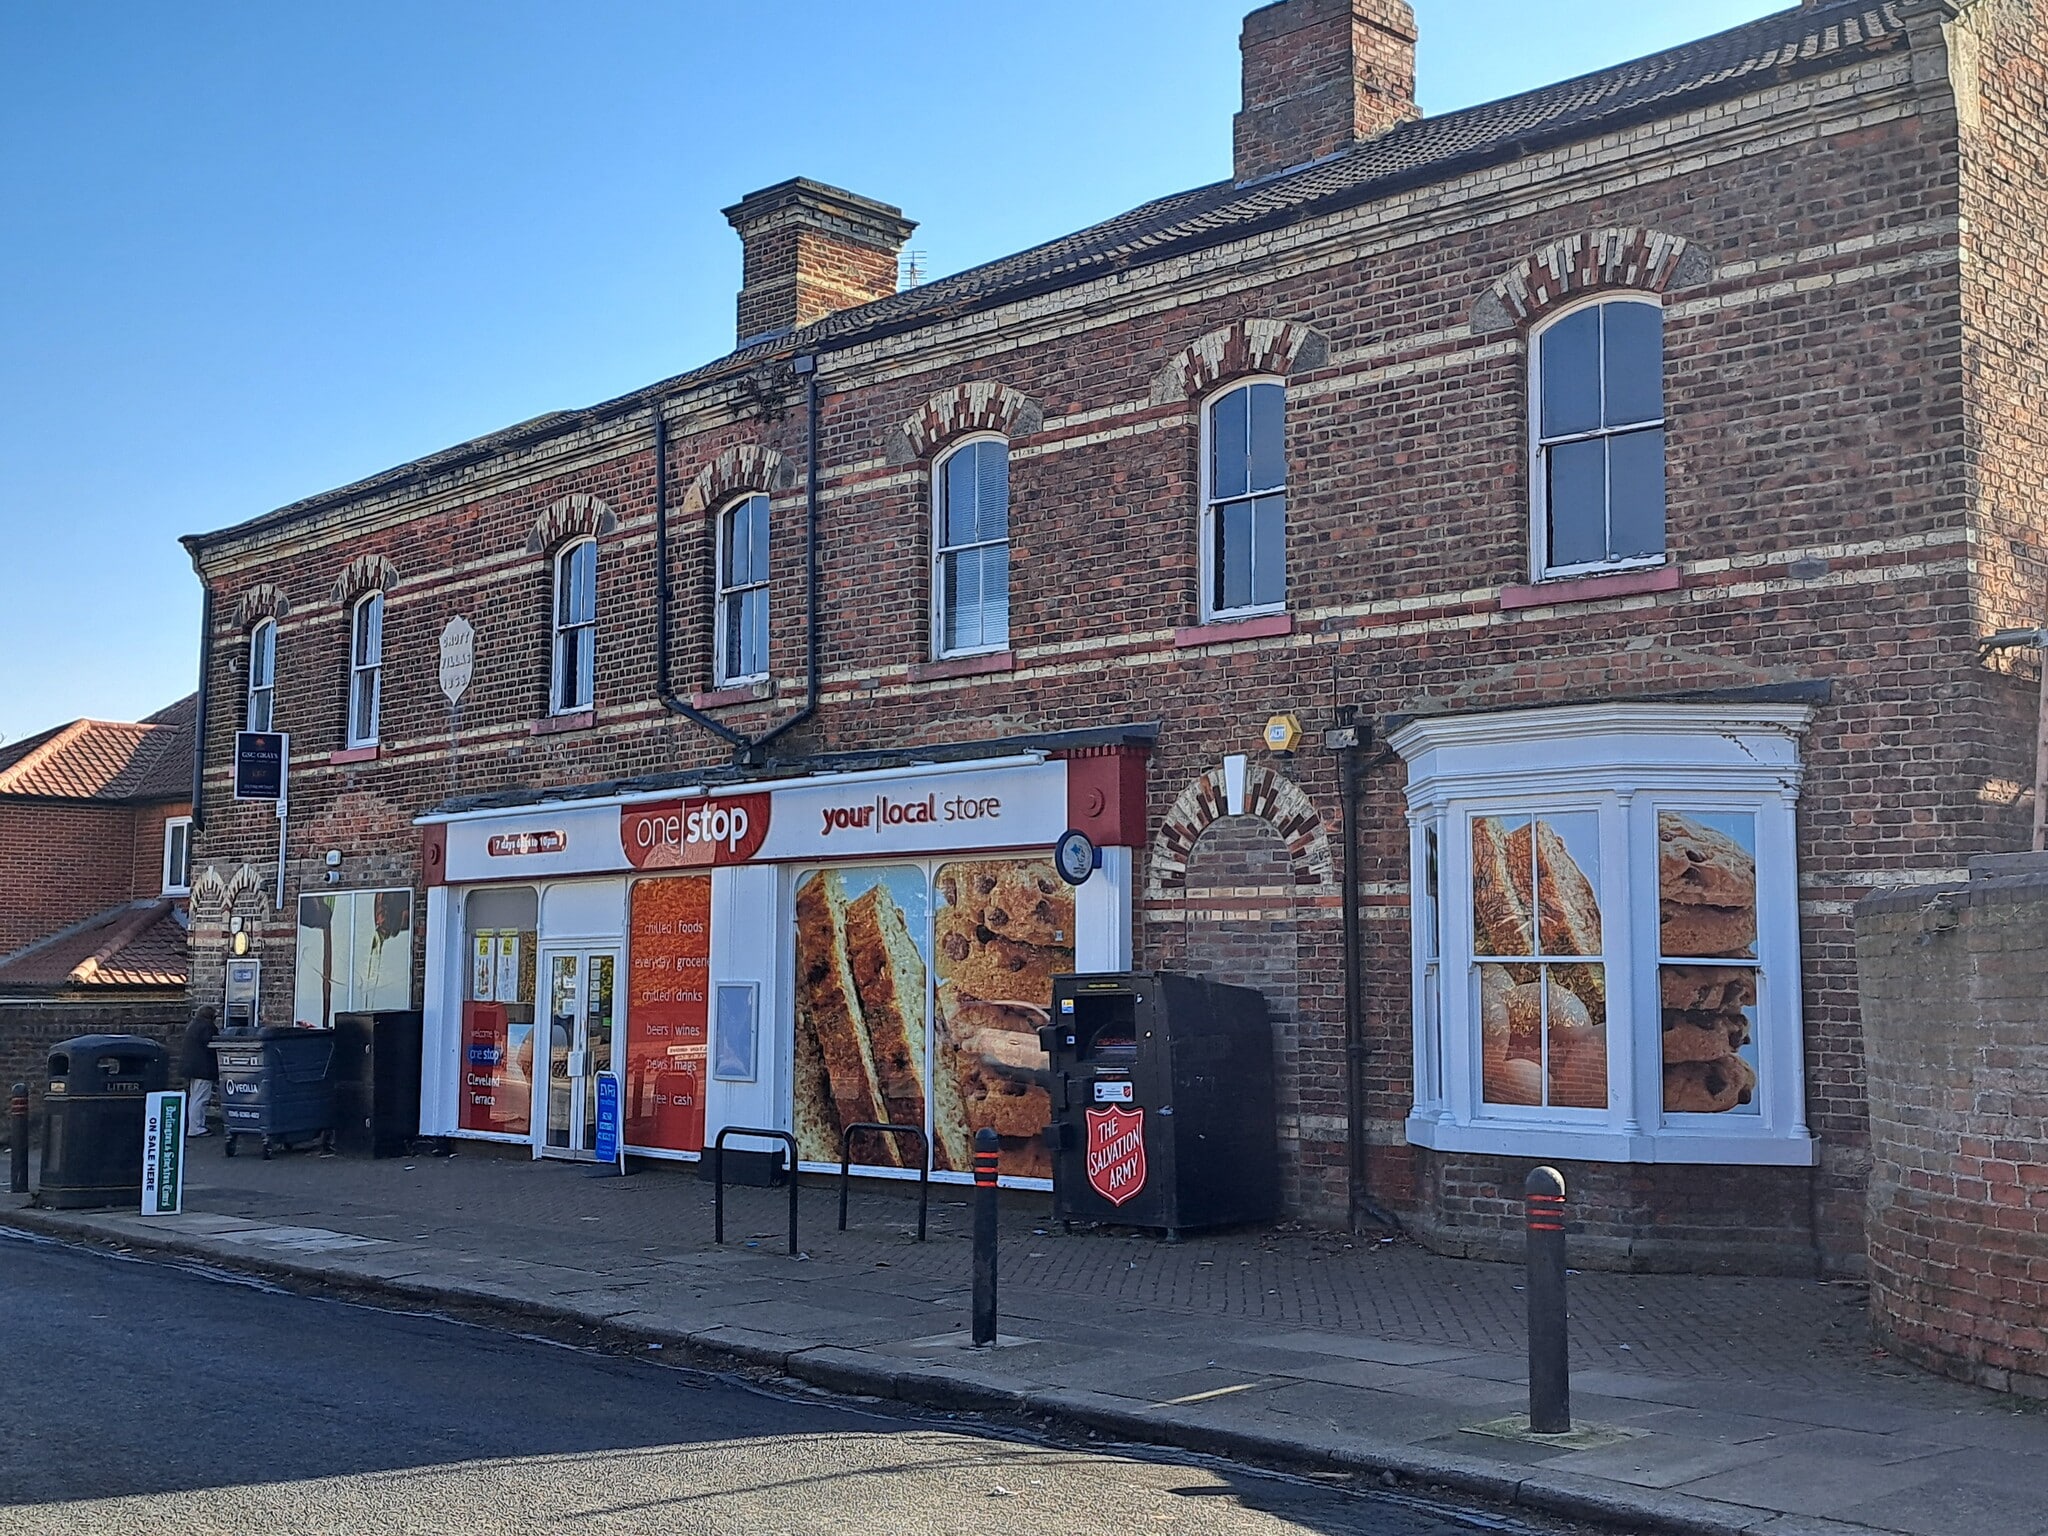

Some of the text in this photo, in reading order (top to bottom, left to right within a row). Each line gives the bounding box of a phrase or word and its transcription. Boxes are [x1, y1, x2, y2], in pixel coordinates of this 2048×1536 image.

[1270, 728, 1285, 739] ADT
[822, 792, 1001, 836] your local store
[686, 801, 748, 853] stop
[495, 840, 500, 850] 7
[501, 837, 515, 852] days
[644, 919, 704, 934] chilled foods
[634, 955, 671, 971] everyday
[642, 988, 703, 1002] chilled drinks
[471, 1029, 493, 1039] welcome
[646, 1022, 700, 1036] beers wines
[469, 1047, 499, 1065] one stop
[646, 1059, 697, 1075] news mags
[107, 1083, 139, 1091] LITTER
[234, 1083, 259, 1093] VEOLIA
[467, 1073, 500, 1088] Cleveland
[470, 1092, 496, 1106] Terrace
[673, 1091, 693, 1106] cash
[1098, 1116, 1119, 1144] THE
[146, 1117, 157, 1191] ON SALE HERE
[1090, 1123, 1141, 1177] SALVATION
[1109, 1152, 1138, 1192] ARMY
